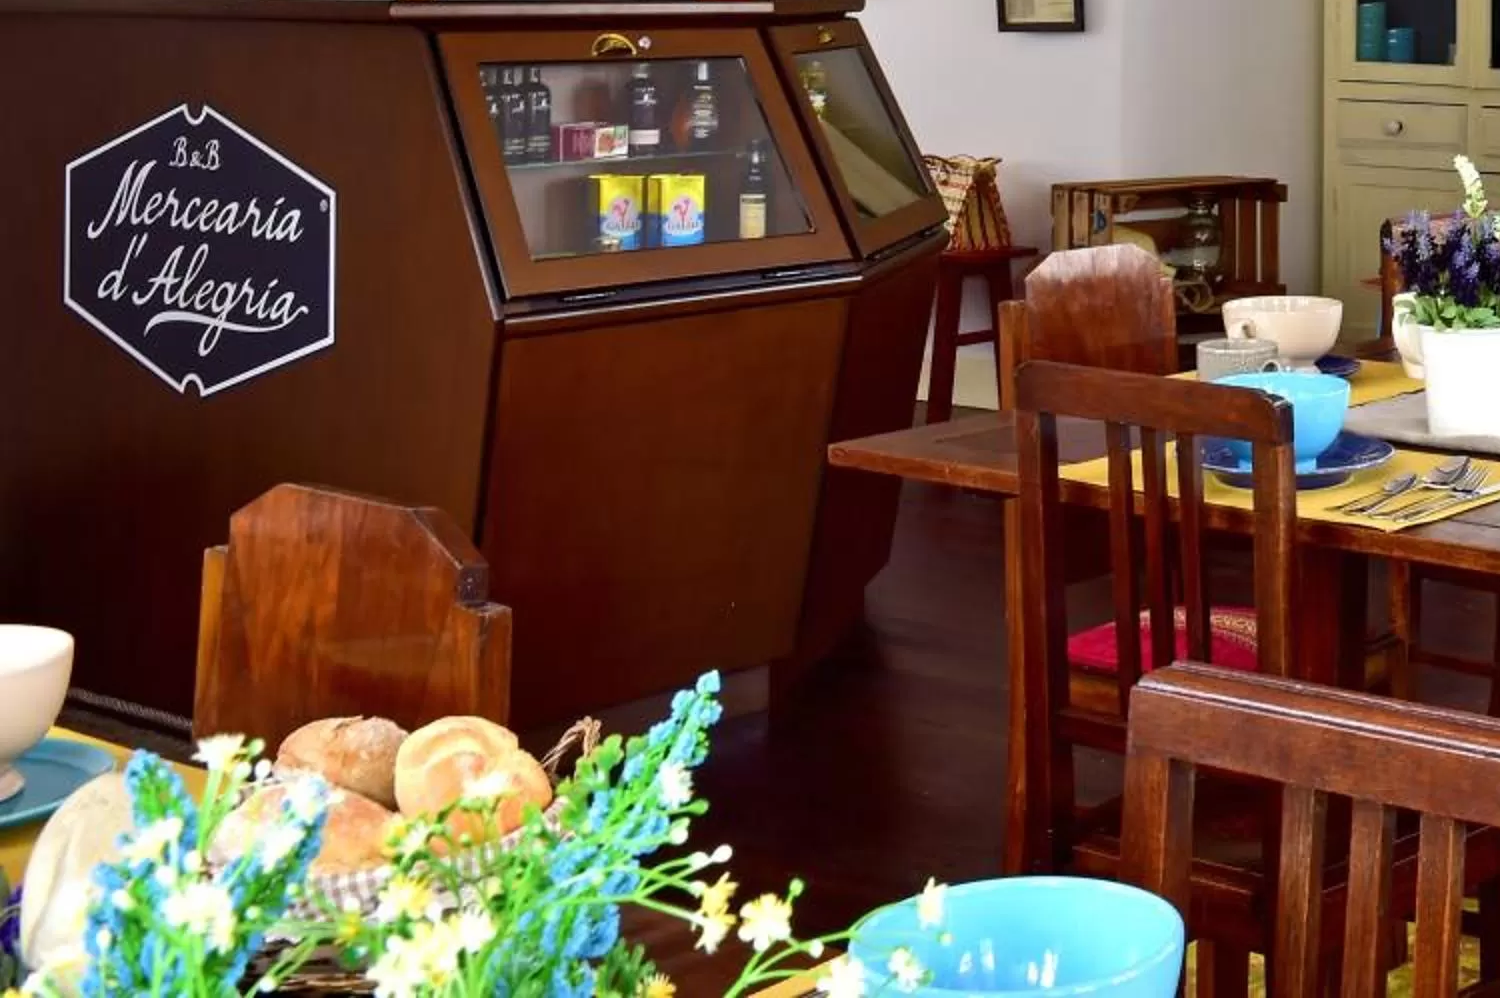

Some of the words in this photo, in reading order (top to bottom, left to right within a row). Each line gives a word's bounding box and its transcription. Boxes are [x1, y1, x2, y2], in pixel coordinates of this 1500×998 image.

[169, 135, 221, 170] B&B
[87, 159, 303, 242] Mercearia
[97, 232, 309, 357] d'Alegria
